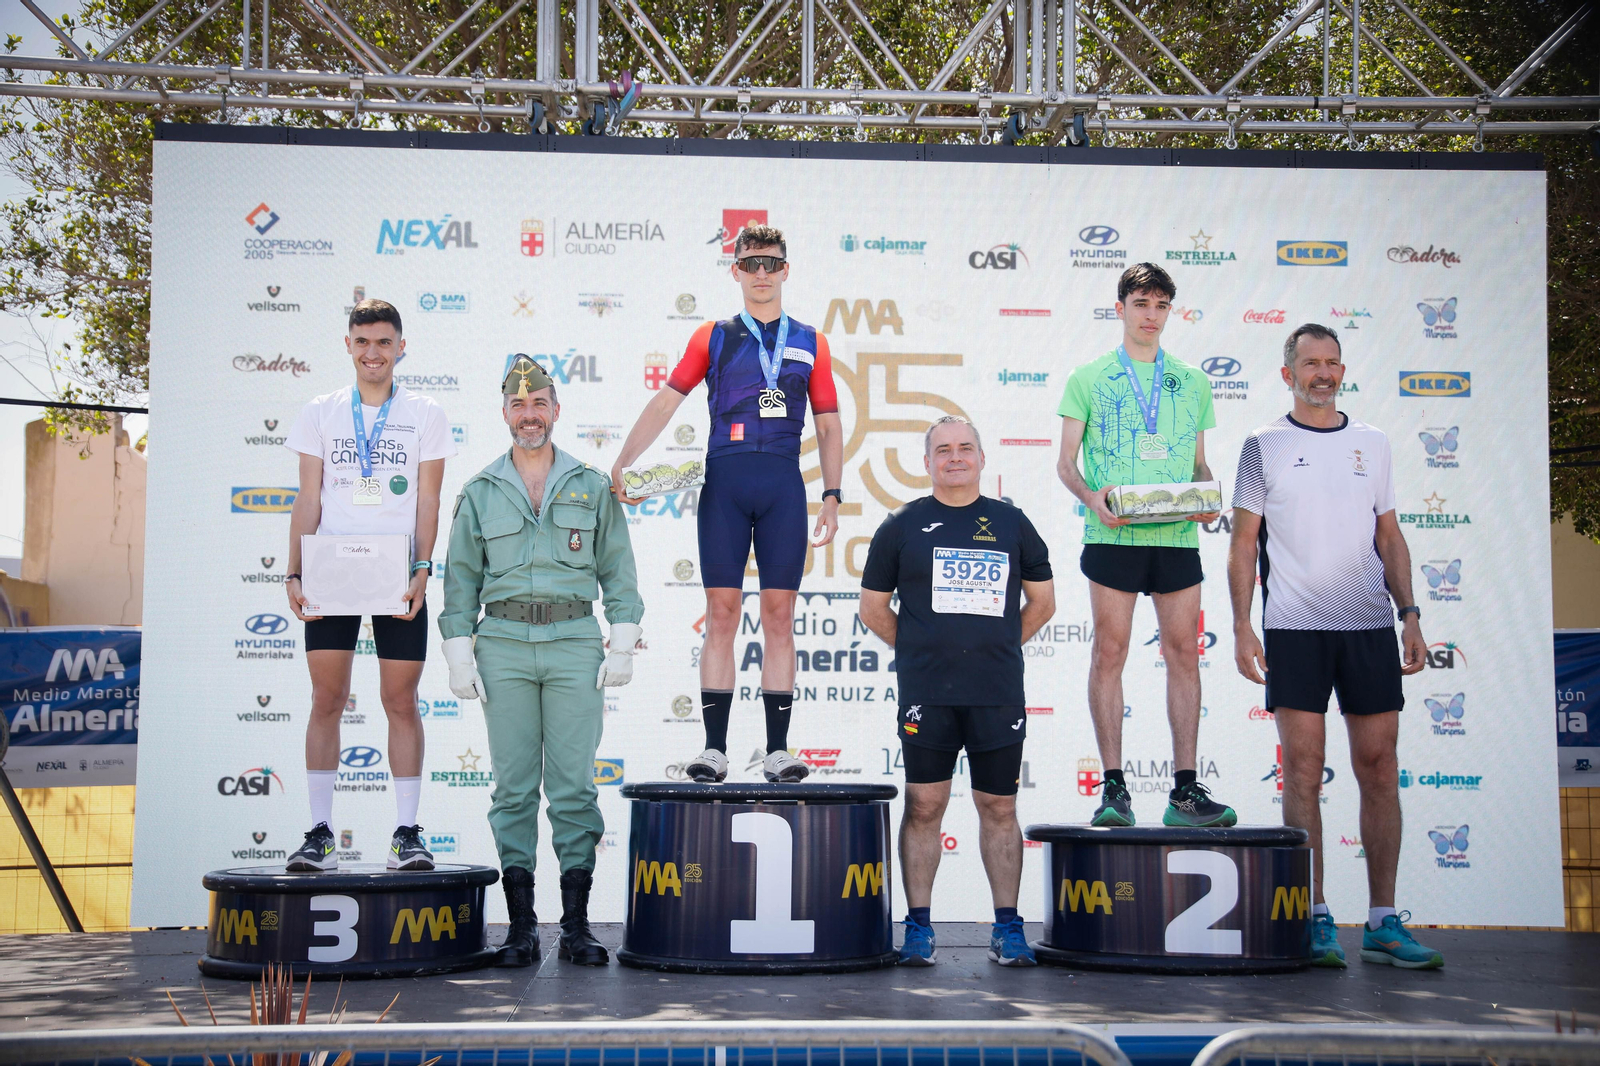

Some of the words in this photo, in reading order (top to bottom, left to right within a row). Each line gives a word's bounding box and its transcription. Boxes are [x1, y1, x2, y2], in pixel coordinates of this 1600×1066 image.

[376, 214, 478, 254] NEXAL
[565, 219, 665, 241] ALMERÍA
[244, 239, 333, 251] COOPERACIÓN
[565, 243, 617, 255] CIUDAD
[863, 236, 927, 253] cajamar
[244, 250, 274, 260] 2005
[1070, 249, 1127, 258] HYUNDAI
[1165, 251, 1237, 261] ESTRELLA
[1286, 248, 1340, 259] IKEA
[969, 251, 1016, 270] CASI
[1072, 260, 1125, 269] Almerialva
[441, 294, 466, 303] SAFA
[247, 301, 300, 312] vellsam
[1210, 381, 1249, 390] UNDAI
[1409, 379, 1463, 390] IKEA
[242, 494, 296, 506] IKEA
[1399, 513, 1472, 524] ESTRELLA
[942, 560, 1001, 582] 5926
[742, 612, 837, 636] Mdio
[235, 639, 295, 649] HYUNDAI
[237, 650, 294, 660] Almerialva
[1425, 650, 1454, 669] ASI
[13, 687, 70, 702] Medio
[77, 686, 140, 700] Marató
[827, 687, 875, 701] RUIZ
[432, 700, 458, 708] SAFA
[10, 701, 139, 733] Almerí
[237, 710, 291, 722] vellsam
[218, 776, 269, 796] CASI
[1418, 771, 1483, 789] cajamar
[430, 836, 455, 844] SAFA
[232, 848, 286, 860] vellsam
[684, 863, 703, 878] 25
[730, 812, 815, 954] 1
[1115, 881, 1135, 896] 25
[1165, 850, 1242, 955] 2
[261, 910, 279, 926] 25
[308, 894, 359, 963] 3
